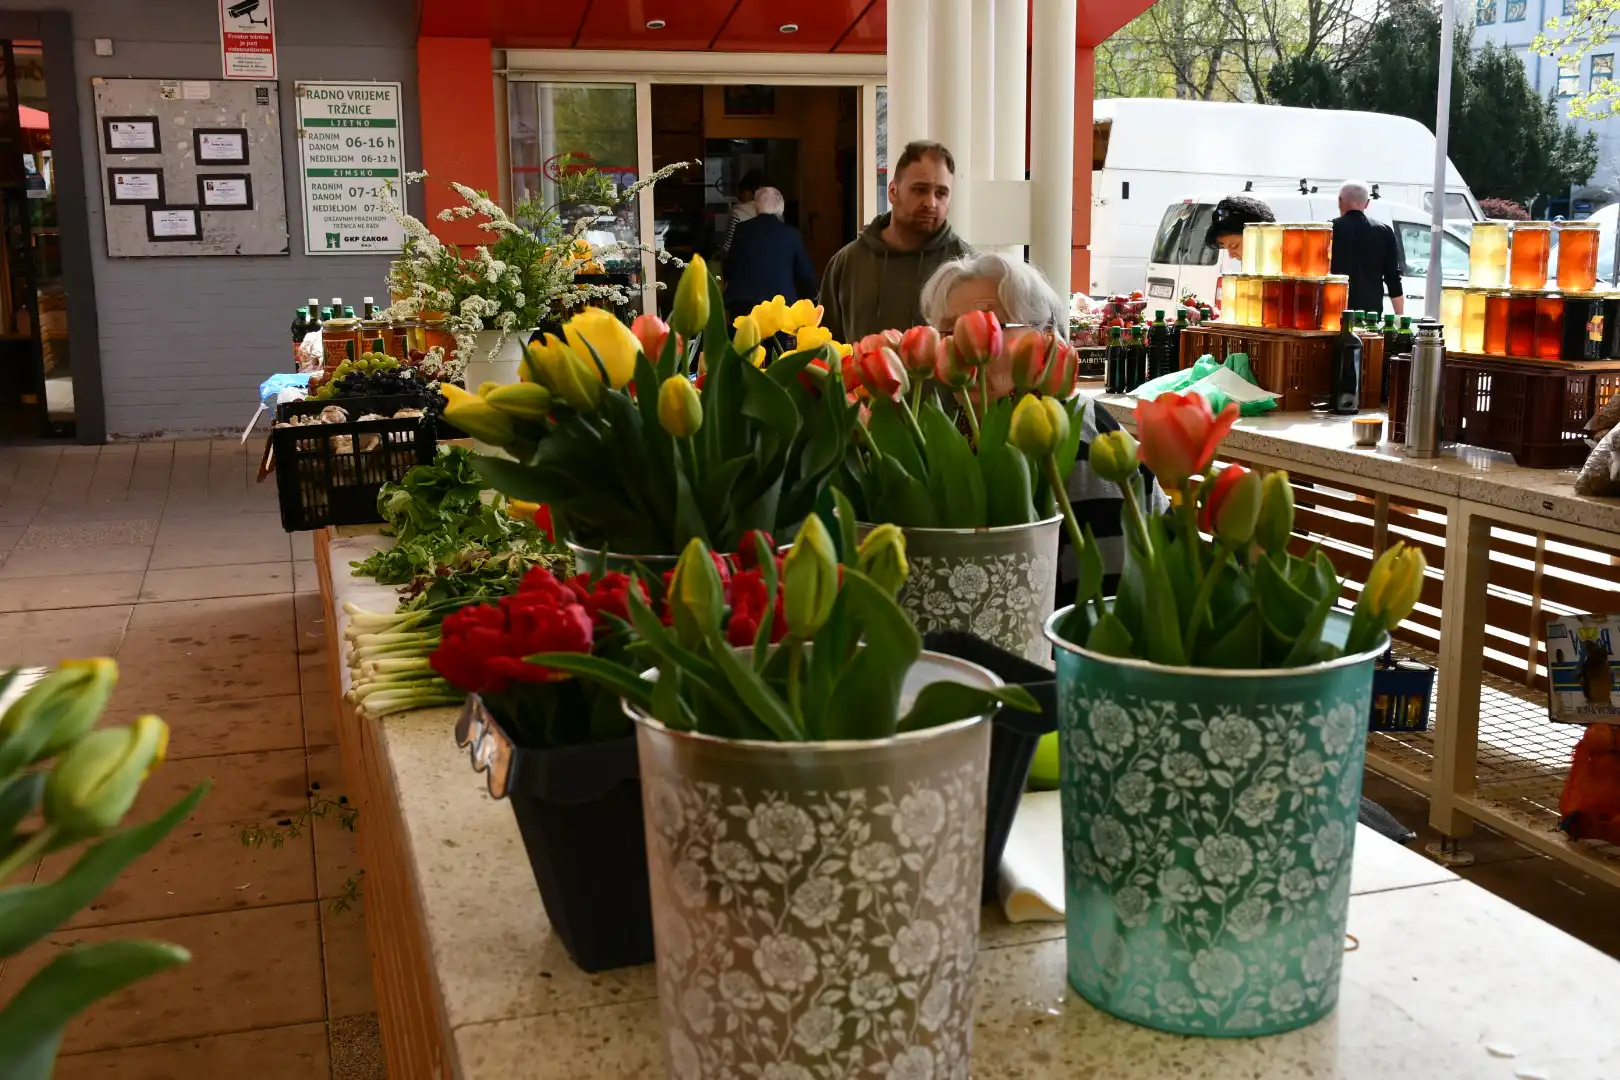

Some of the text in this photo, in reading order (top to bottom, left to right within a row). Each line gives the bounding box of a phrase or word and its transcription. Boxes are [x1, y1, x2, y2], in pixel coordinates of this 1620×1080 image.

[306, 89, 391, 101] RADNO VRIJEME
[327, 103, 371, 115] TRŽNICE
[330, 119, 370, 127] LJETNO
[308, 133, 395, 148] RADNIM 06-16 h
[308, 143, 339, 151] DANOM
[309, 155, 354, 163] NEDJELJOM
[361, 155, 388, 163] 06-12
[333, 169, 373, 177] ZIMSKO
[311, 183, 398, 198] RADNIM 07-1 h
[312, 193, 342, 201] DANOM
[312, 204, 357, 212] NEDJELJOM
